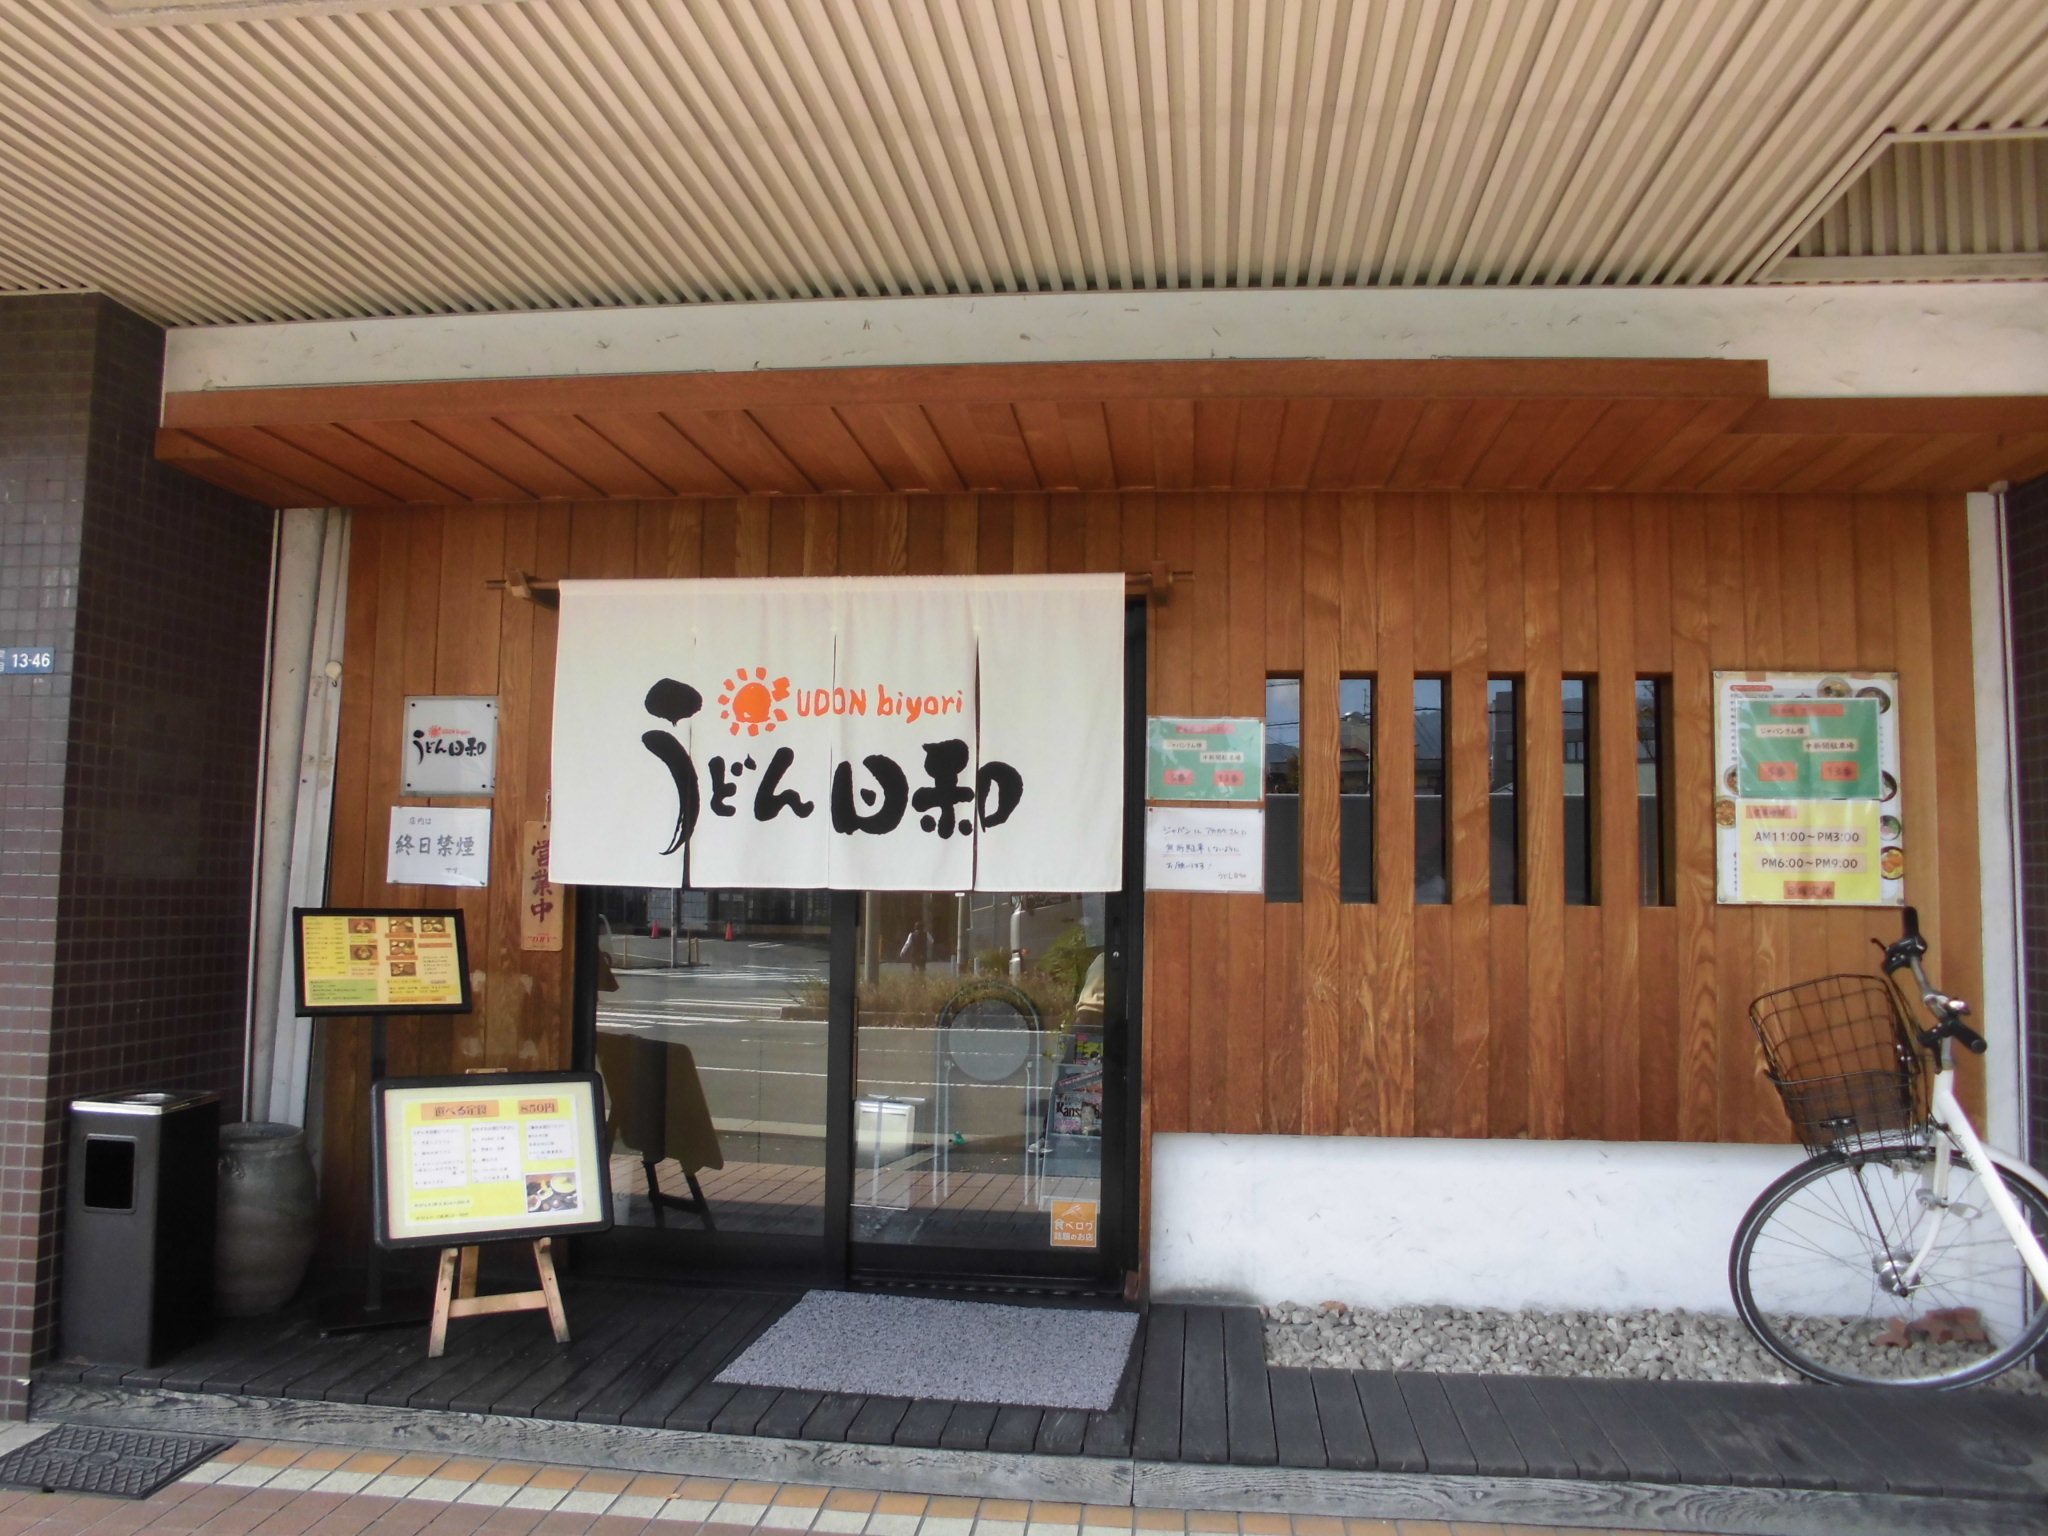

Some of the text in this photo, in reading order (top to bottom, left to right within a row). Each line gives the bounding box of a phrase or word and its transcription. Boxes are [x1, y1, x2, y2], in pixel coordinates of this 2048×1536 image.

[12, 653, 51, 668] 13-46
[797, 684, 964, 723] UDON biyori
[412, 729, 487, 765] うどん日和
[641, 678, 1024, 855] うどん日和
[395, 834, 475, 857] 終日禁煙
[531, 840, 554, 923] 営業中
[520, 1102, 556, 1114] 850円
